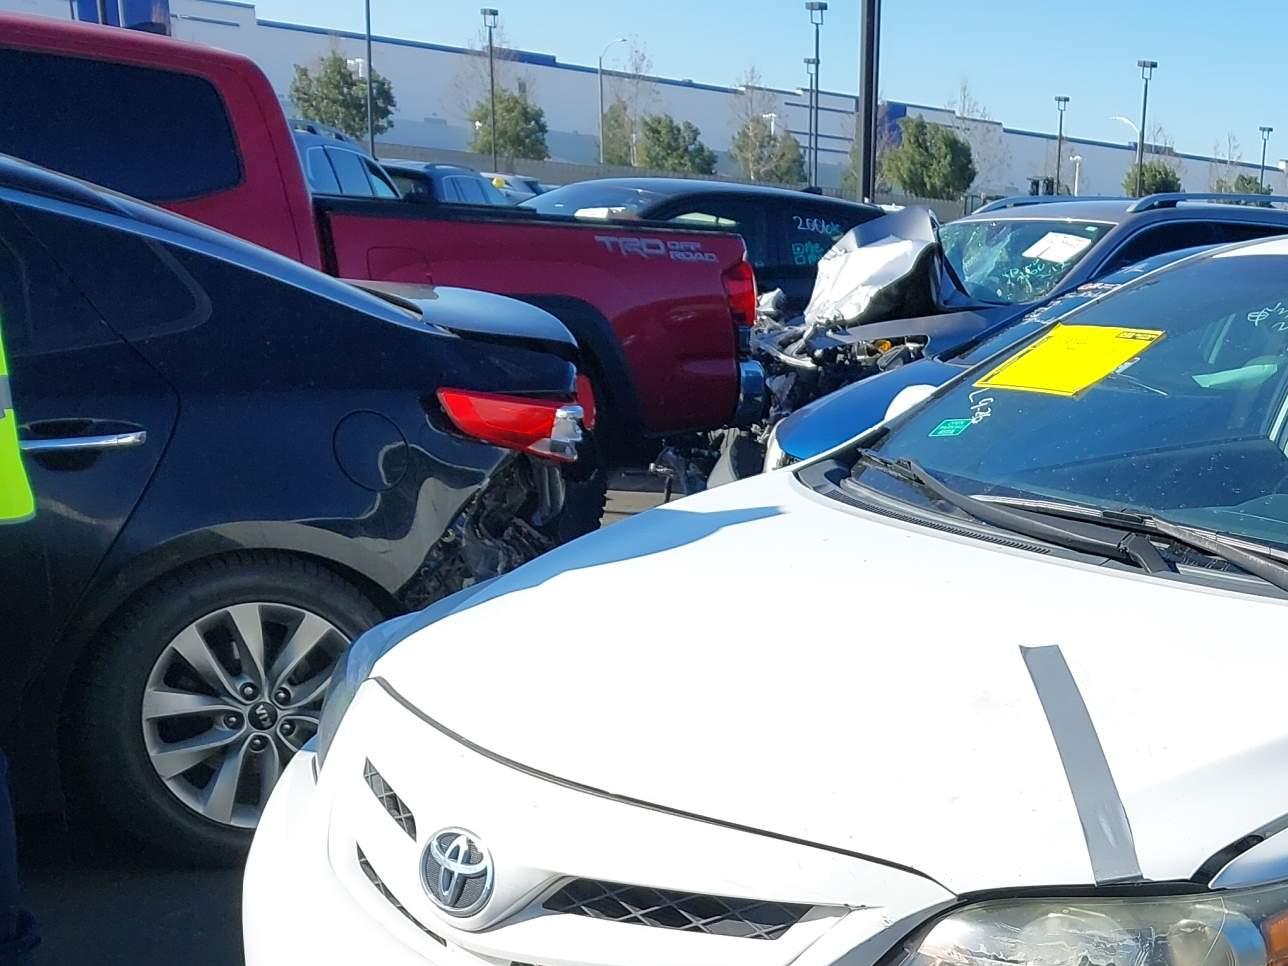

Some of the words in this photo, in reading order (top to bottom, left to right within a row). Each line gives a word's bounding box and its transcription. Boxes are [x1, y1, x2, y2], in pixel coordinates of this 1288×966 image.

[594, 235, 666, 258] TRD
[667, 241, 702, 250] OFF
[669, 250, 718, 263] ROAD
